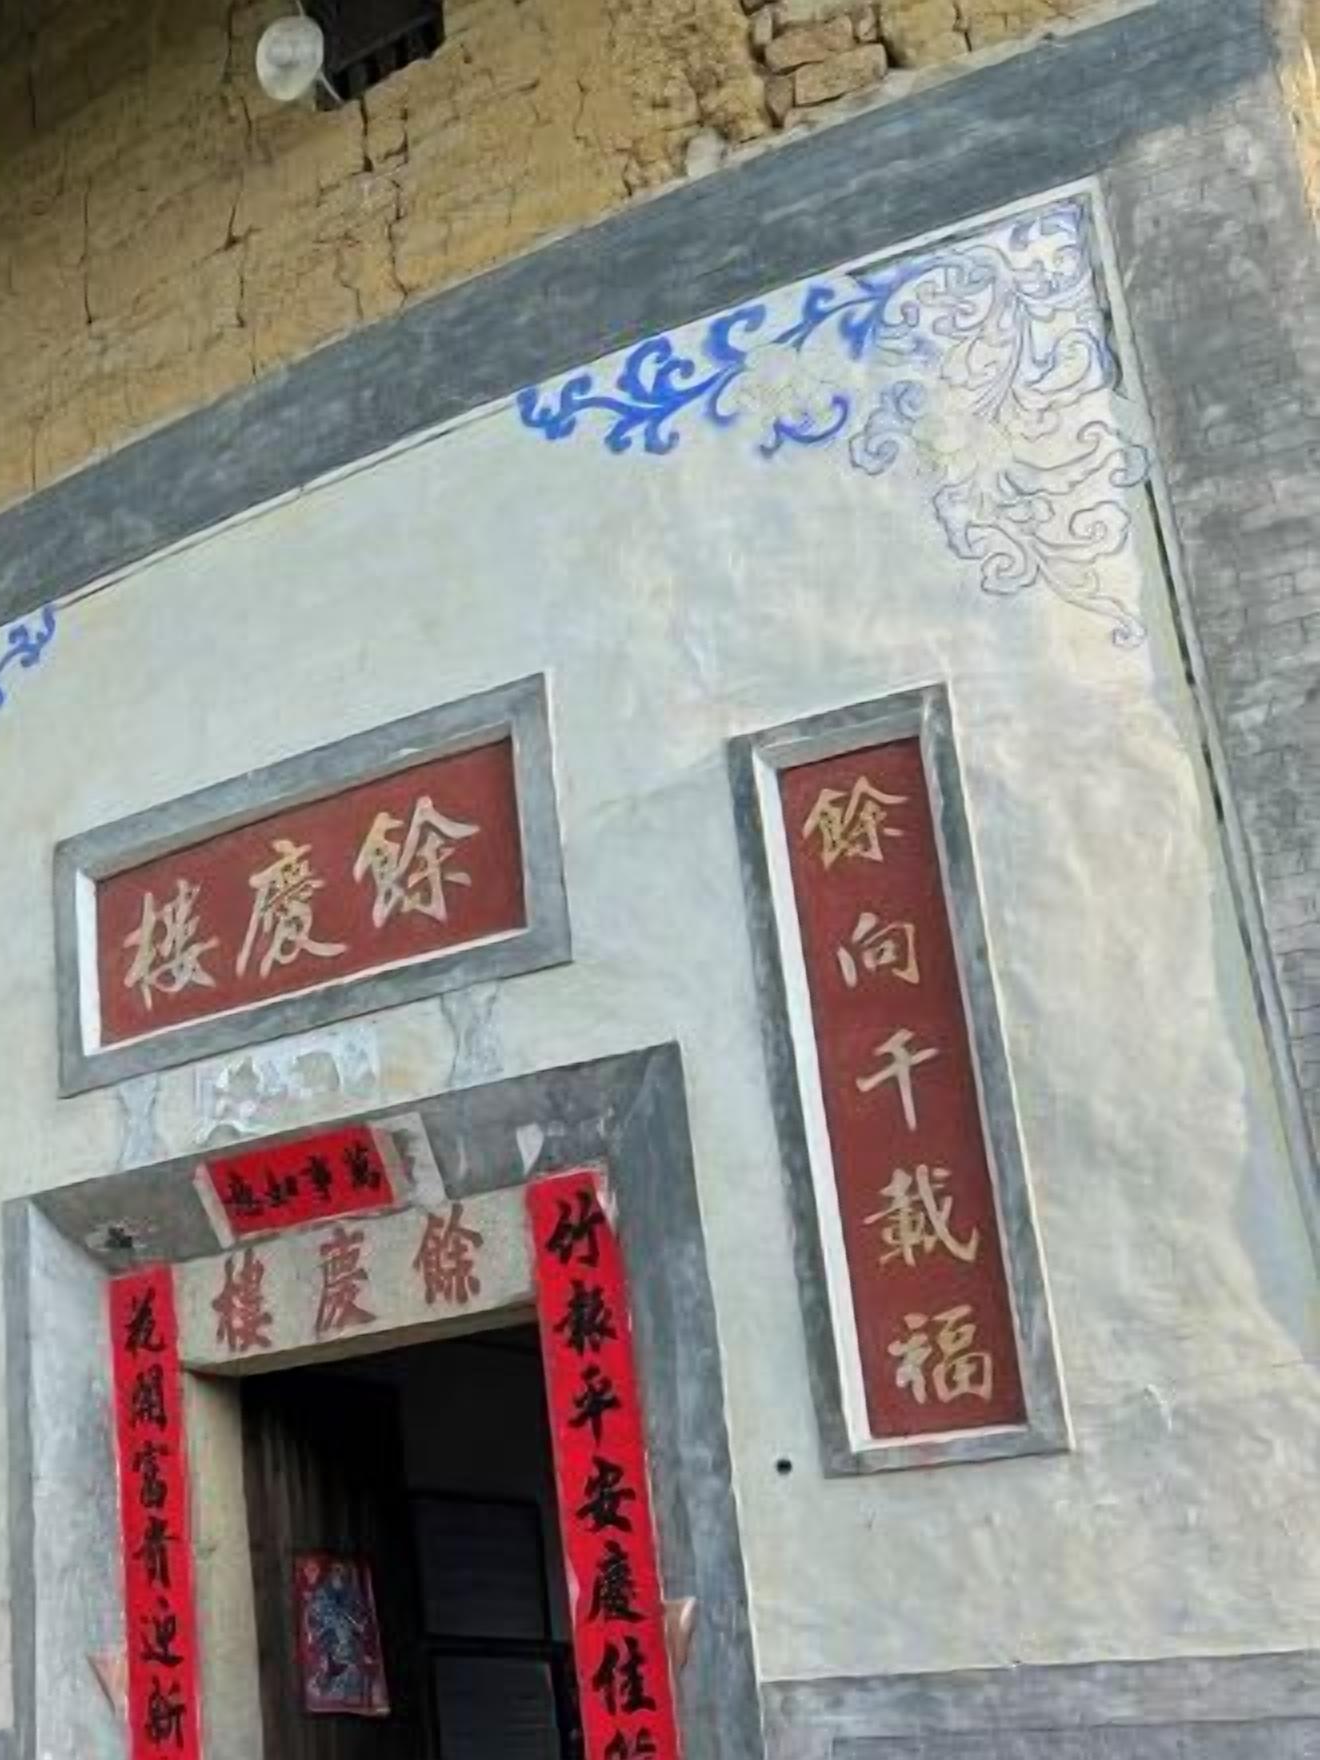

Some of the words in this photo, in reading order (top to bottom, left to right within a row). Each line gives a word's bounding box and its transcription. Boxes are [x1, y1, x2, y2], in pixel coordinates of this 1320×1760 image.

[123, 796, 481, 1011] 餘慶樓
[802, 775, 996, 1403] 餘向千載福
[211, 1202, 484, 1352] 餘慶樓
